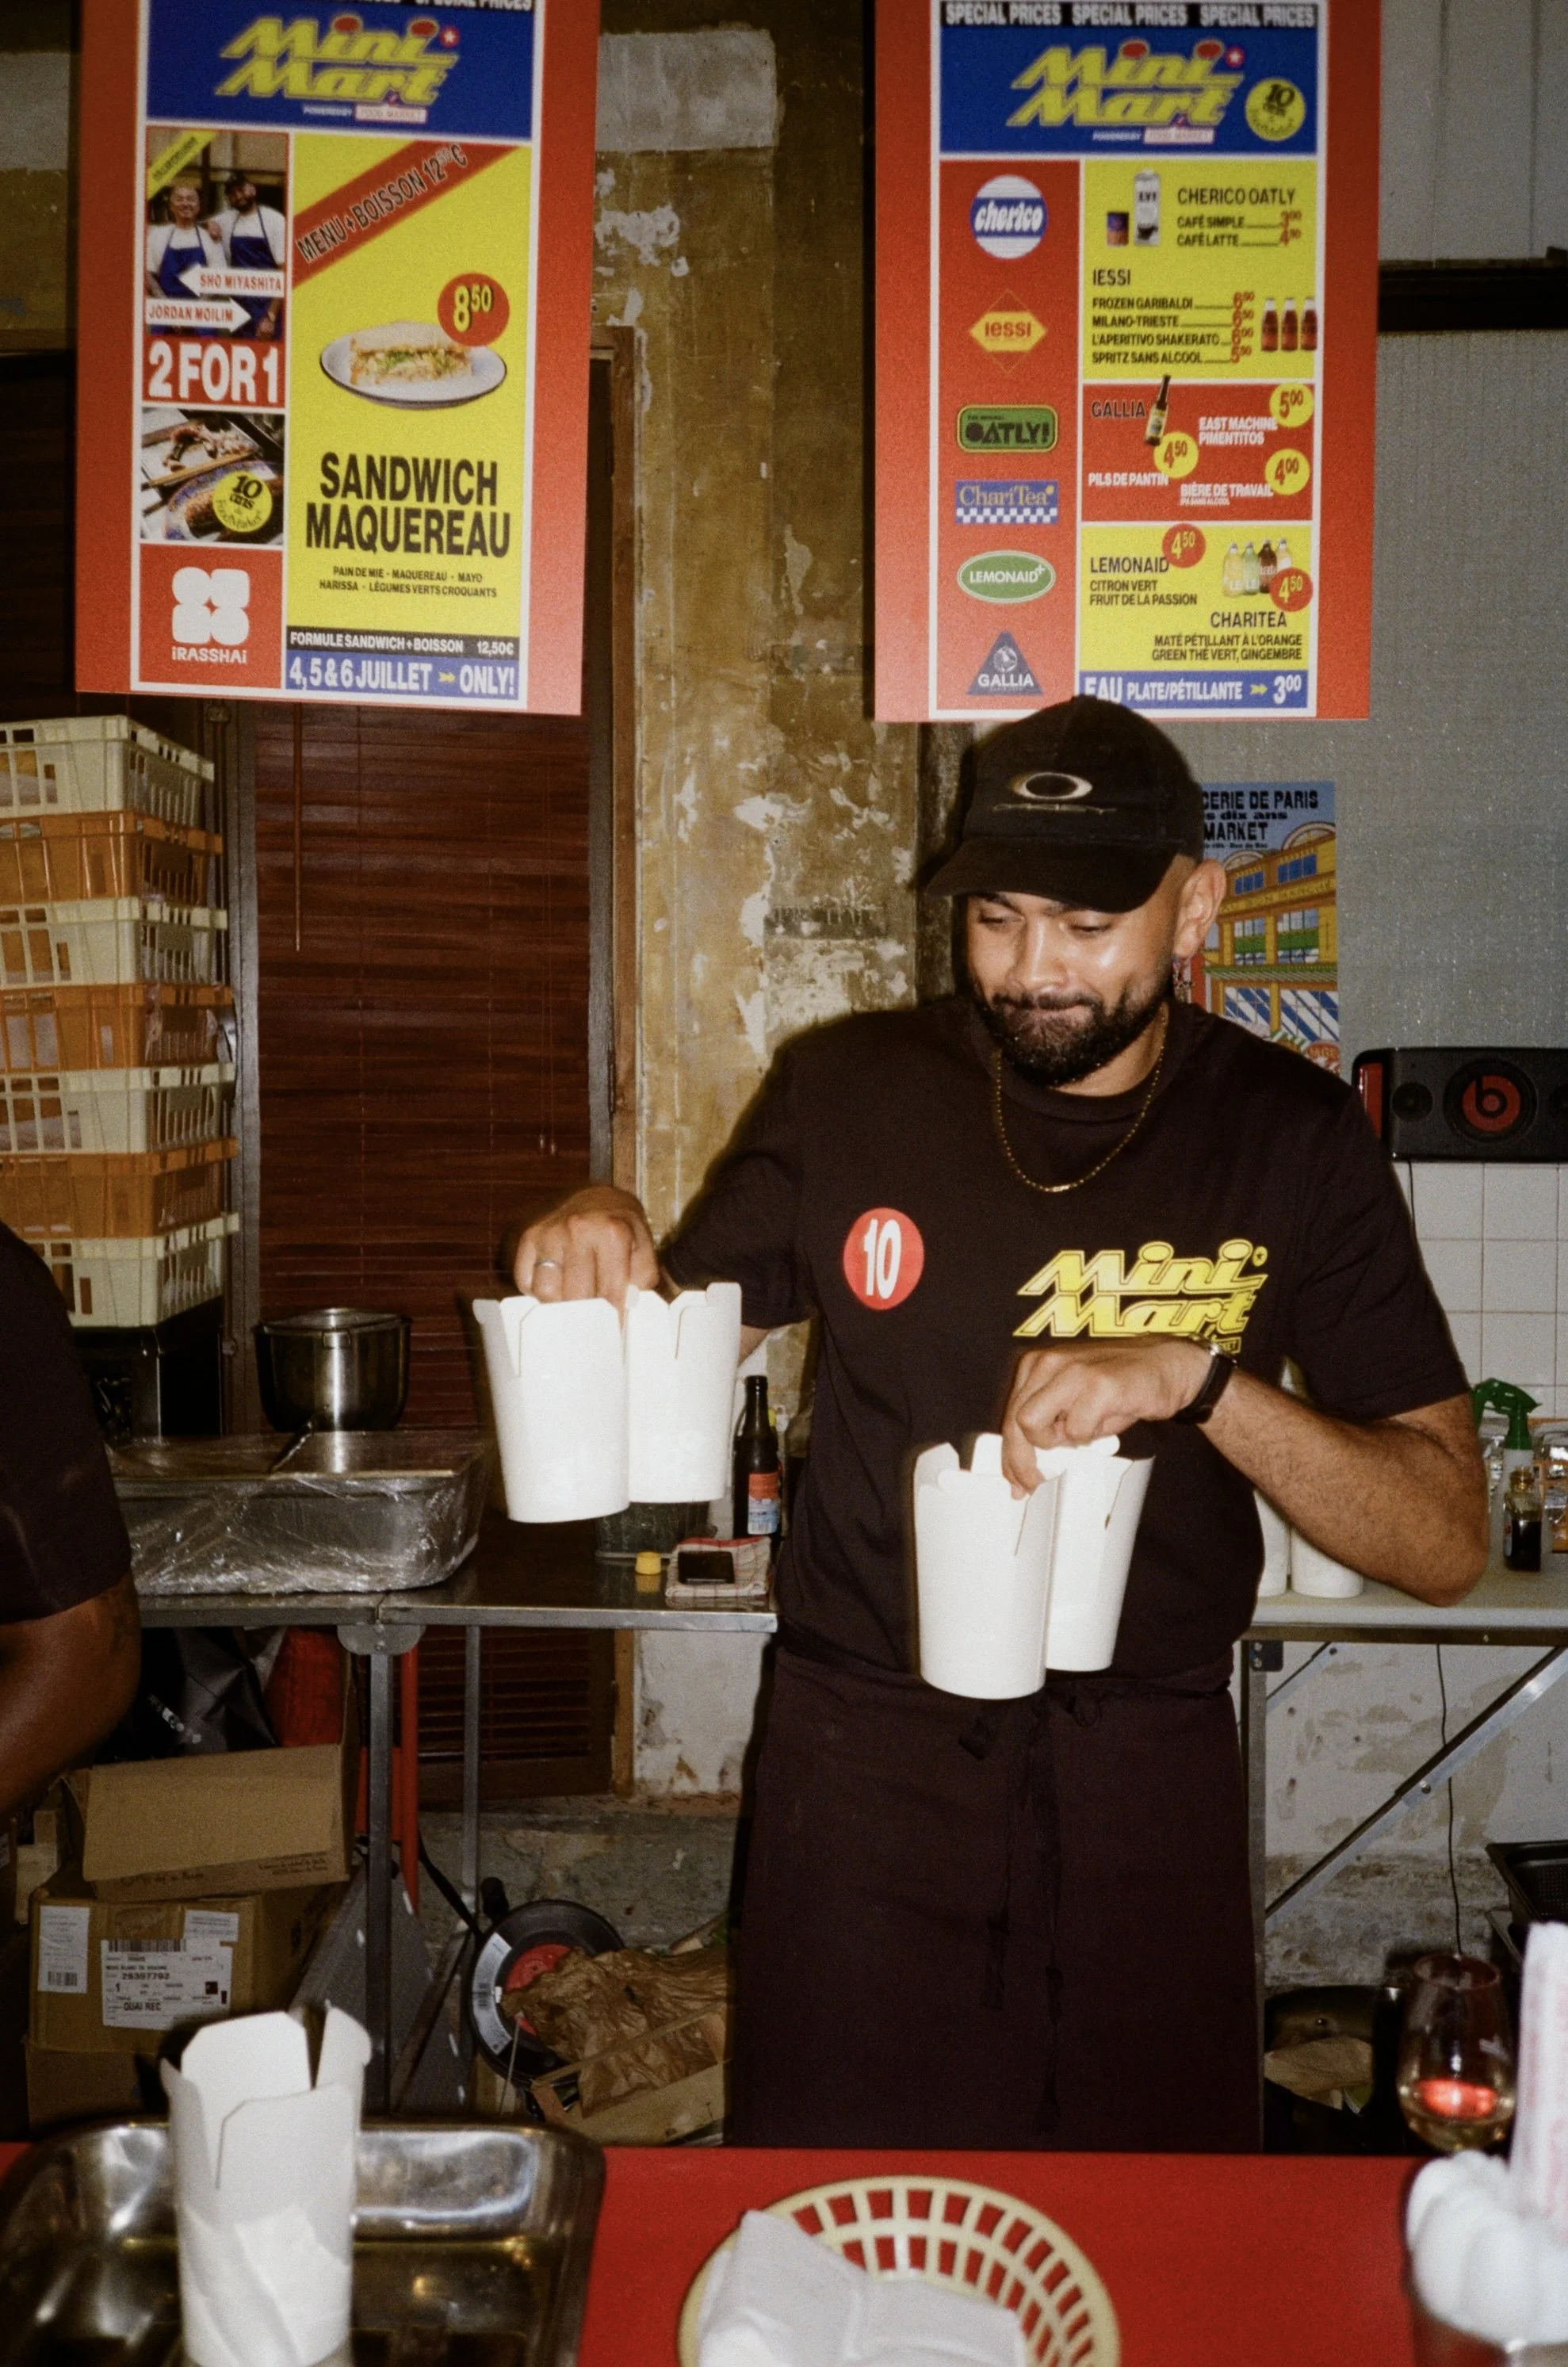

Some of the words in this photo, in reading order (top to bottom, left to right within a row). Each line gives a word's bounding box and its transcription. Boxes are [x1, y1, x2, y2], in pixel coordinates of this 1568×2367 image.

[946, 4, 1007, 25] SPECIAL
[1009, 5, 1062, 26] PRICES
[1072, 5, 1133, 26] SPECIAL
[1135, 5, 1188, 26] PRICES
[1200, 5, 1260, 27] SPECIAL
[1262, 6, 1315, 27] PRICES
[220, 13, 459, 68] Mini
[1011, 38, 1245, 89] Mini
[215, 57, 449, 105] Mart
[1266, 83, 1295, 106] 10
[1005, 84, 1234, 127] Mart
[1177, 188, 1246, 205] CHERICO
[1249, 188, 1296, 205] OATLY
[296, 215, 348, 263] MENU
[350, 166, 428, 229] BOISSON
[974, 201, 1044, 233] cherico
[1177, 214, 1204, 228] CAFÉ
[1207, 216, 1245, 229] SIMPLE
[1177, 231, 1204, 247] CAFÉ
[1207, 234, 1239, 247] LATTE
[200, 274, 222, 287] SHO
[224, 275, 282, 291] MIYASHITA
[1092, 269, 1131, 286] IESSI
[149, 305, 193, 319] JORDAN
[1092, 297, 1134, 309] FROZEN
[1136, 297, 1193, 309] GARIBALDI
[1092, 351, 1130, 364] SPRITZ
[1130, 351, 1160, 364] SANS
[1161, 351, 1203, 364] ALCOOL
[148, 340, 173, 398] 2
[179, 342, 257, 403] FOR
[262, 346, 278, 403] 1
[1091, 400, 1146, 419] GALLIA
[1279, 389, 1304, 418] 500
[965, 421, 1050, 444] OATLY!
[1199, 417, 1228, 430] EAST
[1229, 417, 1278, 431] MACHINE
[1199, 431, 1264, 445] PIMENTITOS
[1163, 440, 1187, 469] 450
[320, 451, 498, 507] SANDWICH
[1088, 472, 1112, 486] PILS
[1113, 473, 1128, 486] DE
[1129, 473, 1169, 486] PANTIN
[1275, 457, 1299, 486] 400
[232, 476, 262, 498] 10
[958, 484, 1050, 507] ChariTea
[1213, 483, 1228, 497] DE
[1229, 483, 1274, 498] TRAVAIL
[306, 501, 511, 558] MAQUEREAU
[1171, 531, 1196, 560] 450
[1090, 556, 1169, 573] LEMONAID
[333, 566, 354, 577] PAIN
[356, 567, 366, 578] DE
[369, 568, 384, 579] MIE
[392, 568, 448, 582] MAQUEREAU
[457, 572, 484, 583] MAYO
[319, 579, 359, 591] HARISSA
[369, 581, 411, 594] LÉGUMES
[412, 584, 441, 595] VERTS
[442, 586, 498, 598] CROQUANTS
[1090, 579, 1130, 591] CITRON
[1131, 579, 1158, 591] VERT
[1090, 595, 1120, 606] FRUIT
[1122, 595, 1135, 606] DE
[1137, 595, 1150, 606] LA
[1152, 594, 1198, 606] PASSION
[1210, 611, 1287, 629] CHARITEA
[290, 631, 345, 648] FORMULE
[345, 633, 405, 651] SANDWICH
[414, 637, 464, 653] BOISSON
[476, 640, 515, 658] 12,50€
[1154, 633, 1183, 646] MATÉ
[1184, 633, 1241, 647] PÉTILLANT
[1252, 634, 1302, 646] L'ORANGE
[1152, 648, 1187, 661] GREEN
[1210, 648, 1239, 663] VERT,
[1241, 648, 1302, 660] GINGEMBRE
[310, 657, 323, 686] 5
[324, 658, 339, 687] &
[340, 659, 354, 688] 6
[355, 660, 434, 691] JUILLET
[459, 664, 516, 696] ONLY!
[977, 673, 1034, 687] GALLIA
[1274, 674, 1302, 705] 300
[1249, 790, 1268, 809] DE
[1274, 790, 1319, 809] PARIS
[1220, 811, 1248, 820] dix
[1253, 812, 1289, 820] ans
[1203, 822, 1268, 841] MARKET
[862, 1218, 902, 1300] 10
[1017, 1238, 1268, 1296] Mini
[1012, 1289, 1258, 1338] Mart
